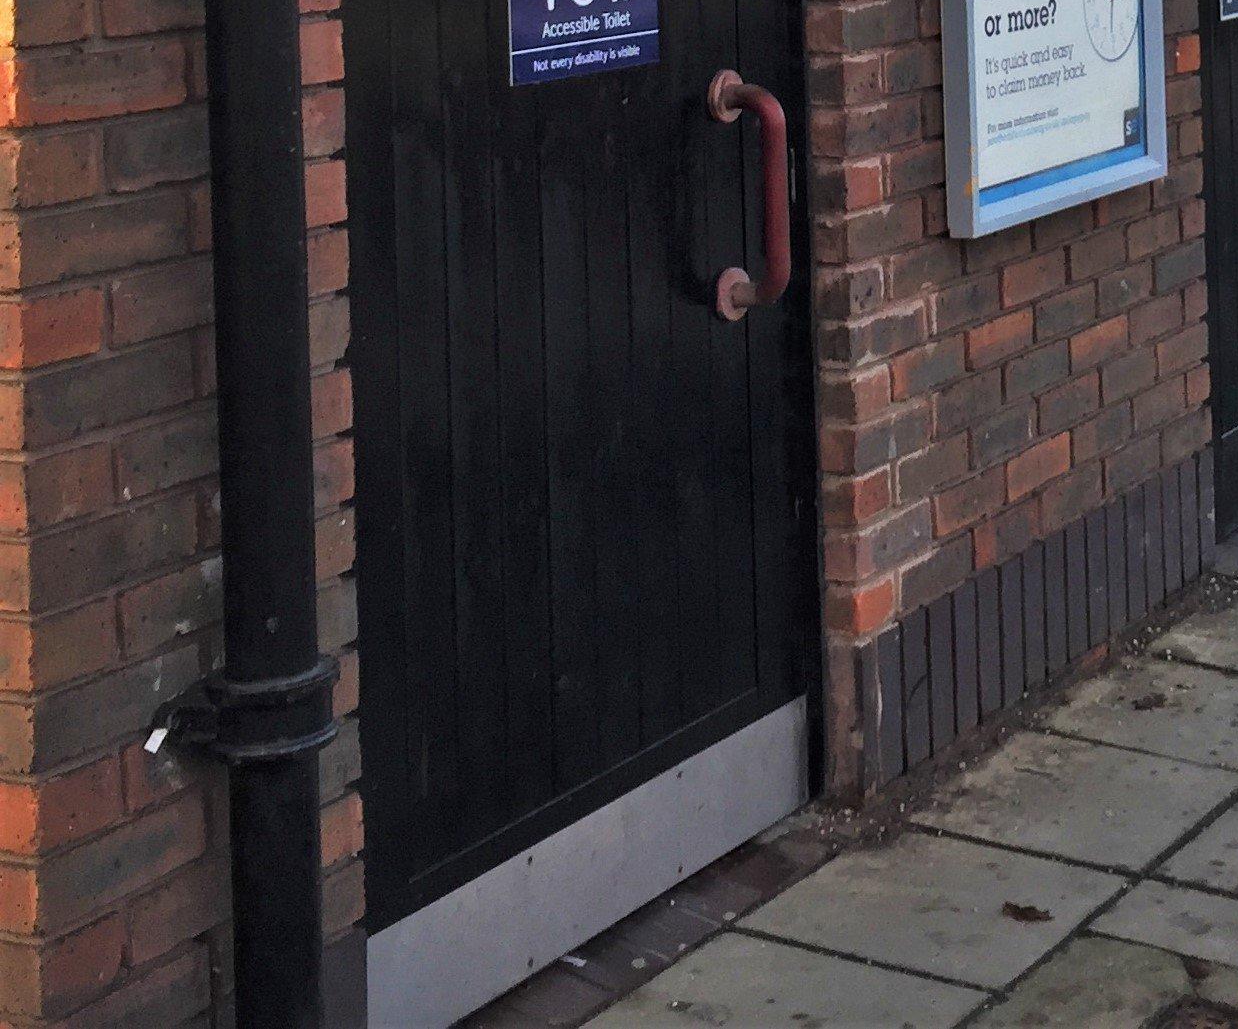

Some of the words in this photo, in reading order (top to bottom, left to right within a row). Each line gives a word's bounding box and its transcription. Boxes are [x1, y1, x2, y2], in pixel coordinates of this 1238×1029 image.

[541, 15, 601, 39] Accessible
[602, 10, 632, 30] Toilet
[984, 15, 1002, 38] or
[533, 58, 549, 73] Not
[550, 56, 574, 70] every
[574, 50, 609, 66] disability
[609, 48, 617, 59] is
[617, 44, 641, 59] visible
[985, 57, 1000, 76] It's
[1000, 50, 1029, 75] quick
[1030, 44, 1051, 66] and
[1052, 43, 1075, 62] easy
[986, 84, 997, 100] to
[998, 76, 1027, 97] claim
[1028, 69, 1062, 90] money
[1063, 61, 1087, 81] back
